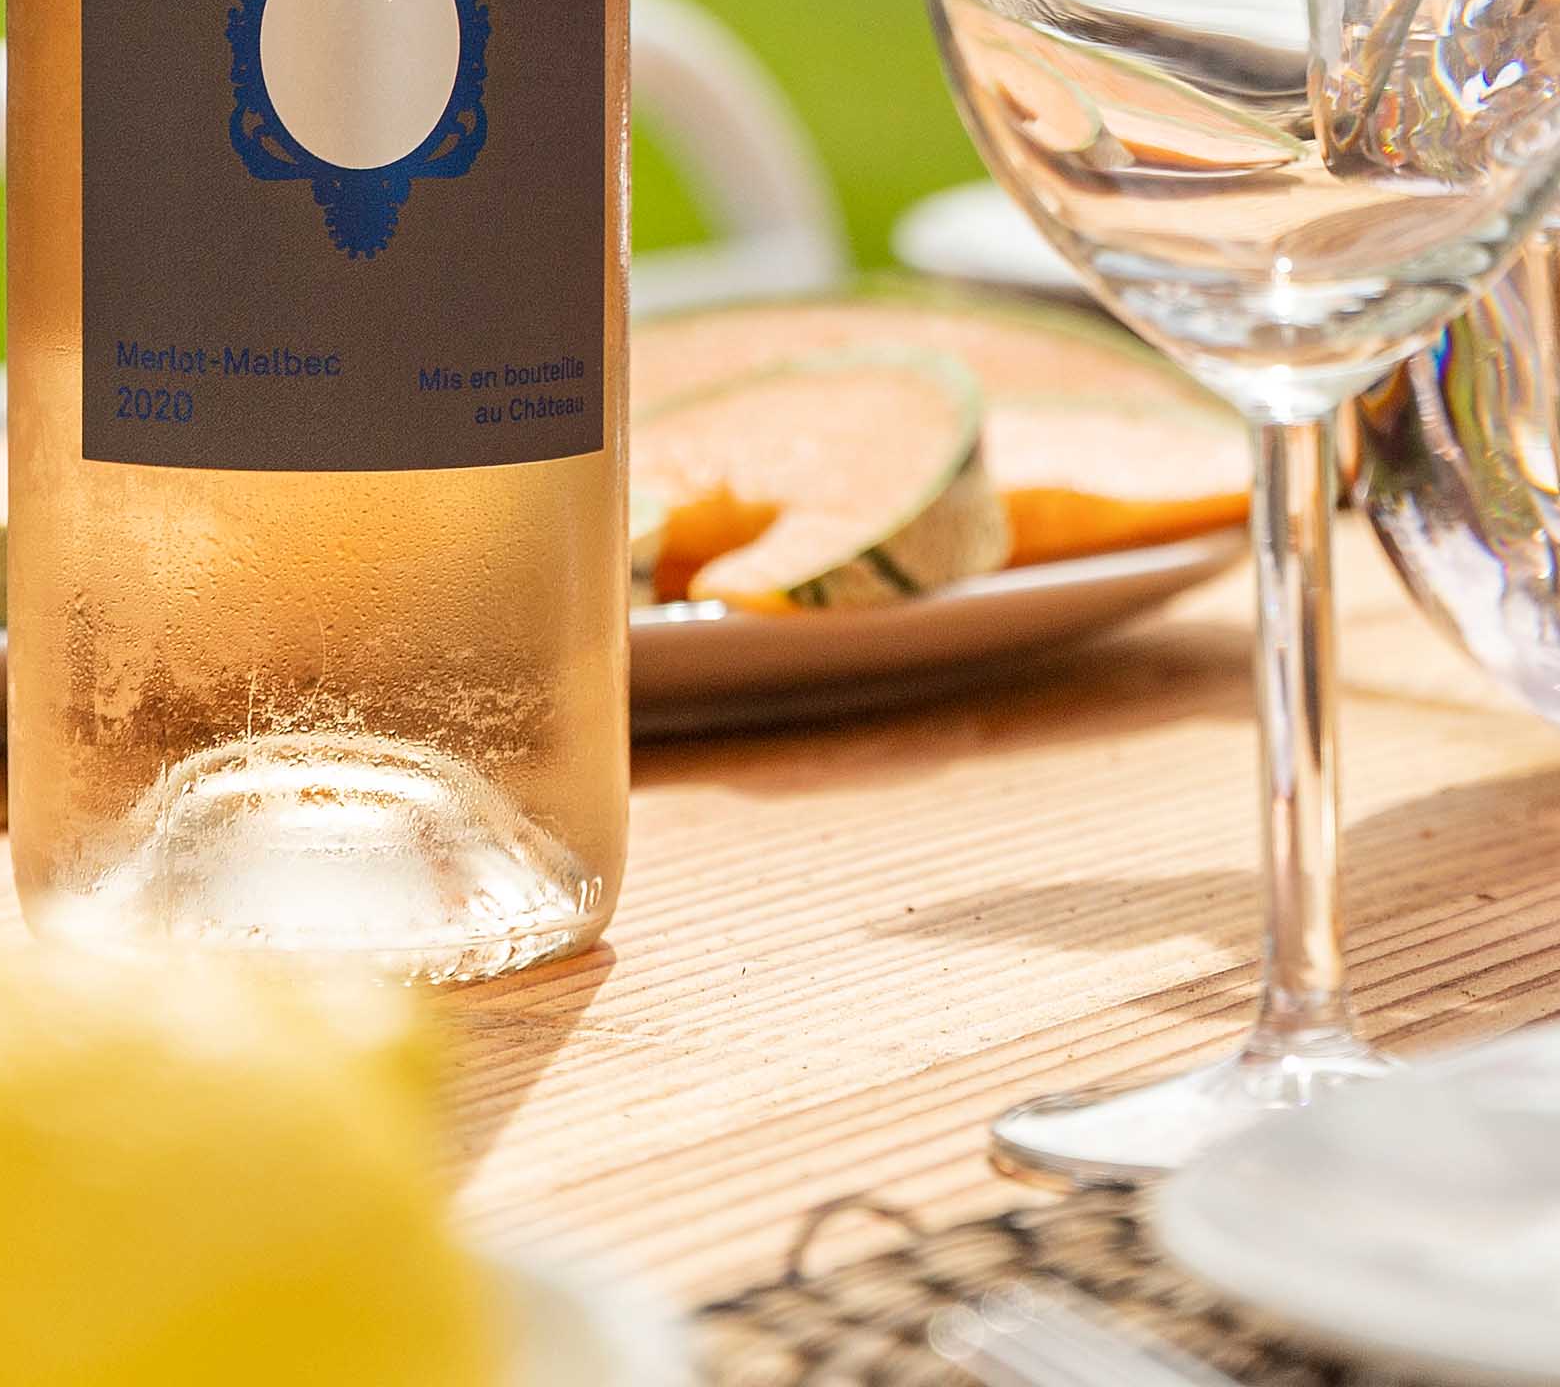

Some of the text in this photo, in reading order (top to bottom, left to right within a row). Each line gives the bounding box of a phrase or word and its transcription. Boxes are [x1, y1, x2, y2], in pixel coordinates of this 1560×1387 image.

[116, 340, 343, 377] Merlot-Malbec
[418, 356, 585, 391] Mis en bouteille
[116, 386, 195, 423] 2020
[474, 394, 585, 425] au Château
